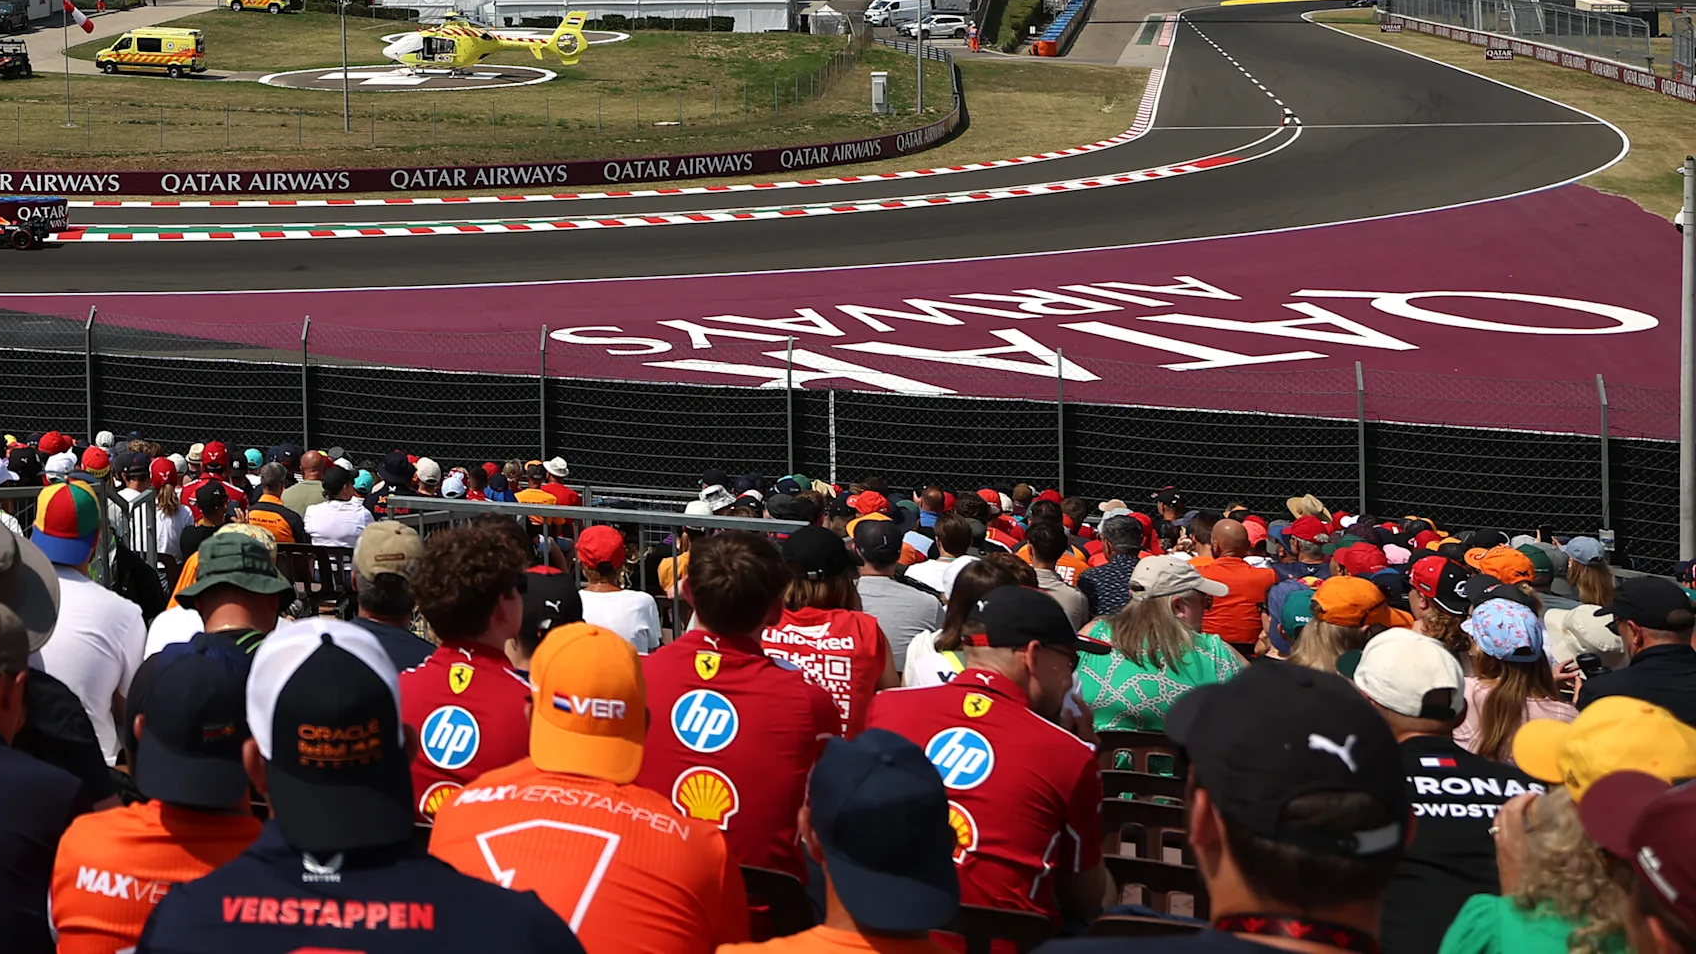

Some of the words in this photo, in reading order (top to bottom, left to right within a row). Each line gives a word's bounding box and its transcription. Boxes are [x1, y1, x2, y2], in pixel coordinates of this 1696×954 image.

[1661, 79, 1676, 96] QATAR
[1677, 83, 1696, 101] AIRWAYS
[604, 160, 673, 182] QATAR
[678, 152, 753, 176] AIRWAYS
[780, 146, 825, 168] QATAR
[830, 139, 881, 162] AIRWAYS
[20, 174, 120, 193] AIRWAYS
[161, 173, 242, 193] QATAR
[247, 171, 350, 191] AIRWAYS
[390, 168, 470, 189] QATAR
[475, 164, 568, 186] AIRWAYS
[18, 205, 65, 221] QATAR
[548, 274, 1242, 357] AIRWAYS
[643, 288, 1660, 395] QATAR
[571, 695, 627, 720] VER
[679, 689, 731, 752] hp
[298, 718, 380, 740] ORACLE
[427, 707, 476, 766] hp
[928, 728, 987, 789] hp
[222, 896, 434, 930] VERSTAPPEN
